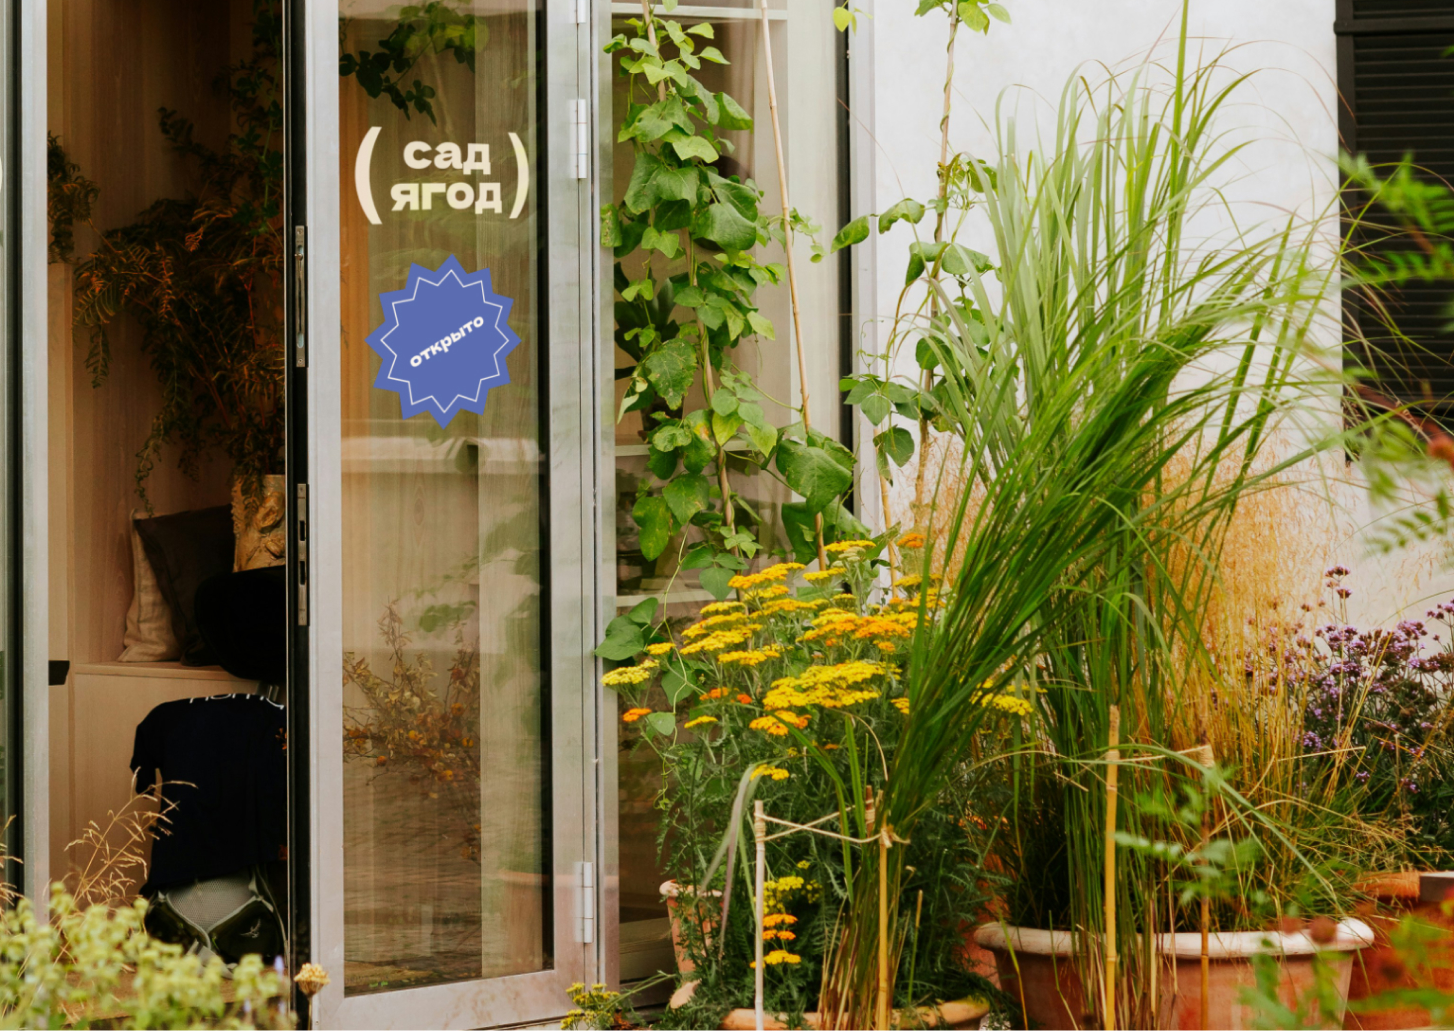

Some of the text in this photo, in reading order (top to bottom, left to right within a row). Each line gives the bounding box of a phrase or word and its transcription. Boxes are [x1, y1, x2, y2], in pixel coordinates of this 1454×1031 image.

[403, 141, 491, 175] сад
[390, 182, 503, 215] ягод
[409, 316, 485, 368] открыто
